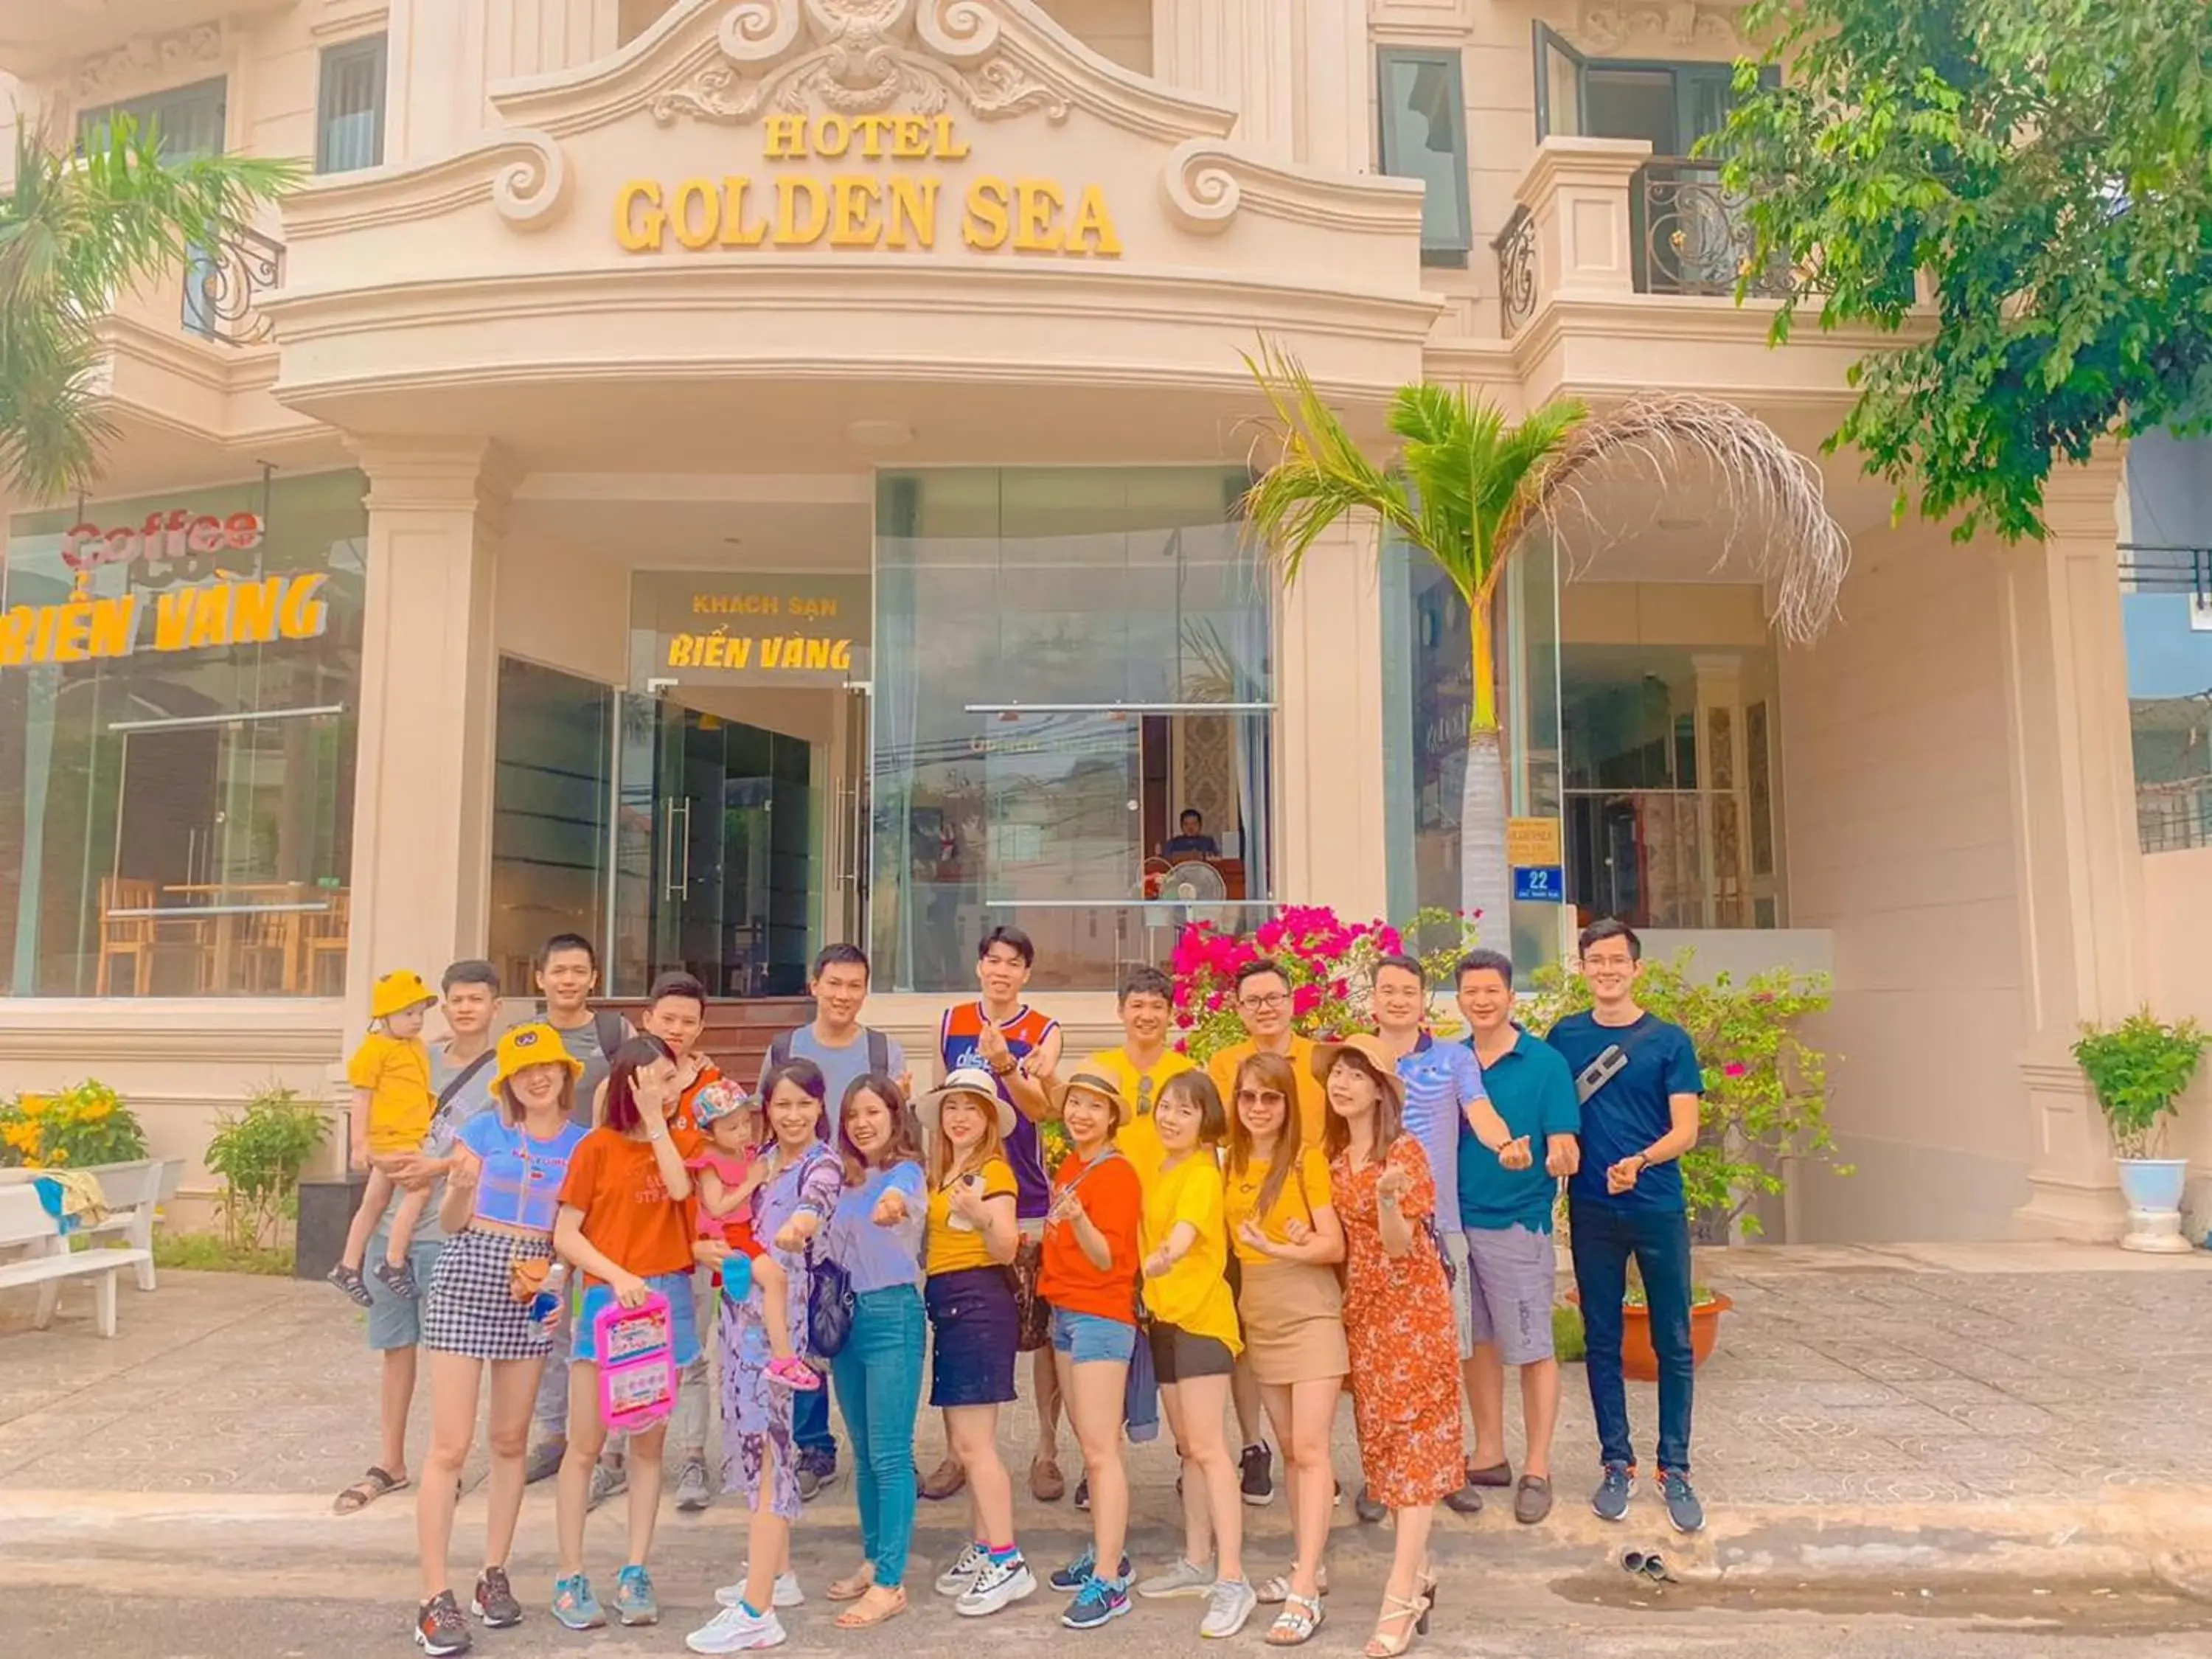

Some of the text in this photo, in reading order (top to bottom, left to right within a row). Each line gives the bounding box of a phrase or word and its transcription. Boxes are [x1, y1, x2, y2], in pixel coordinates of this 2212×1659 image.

[763, 114, 972, 161] HOTEL
[614, 175, 1124, 258] GOLDEN SEA
[61, 509, 264, 570] Coffee
[155, 568, 329, 652] VÀNG
[788, 596, 838, 622] SẠN
[667, 622, 852, 670] BIỂN VÀNG
[1528, 871, 1548, 889] 22
